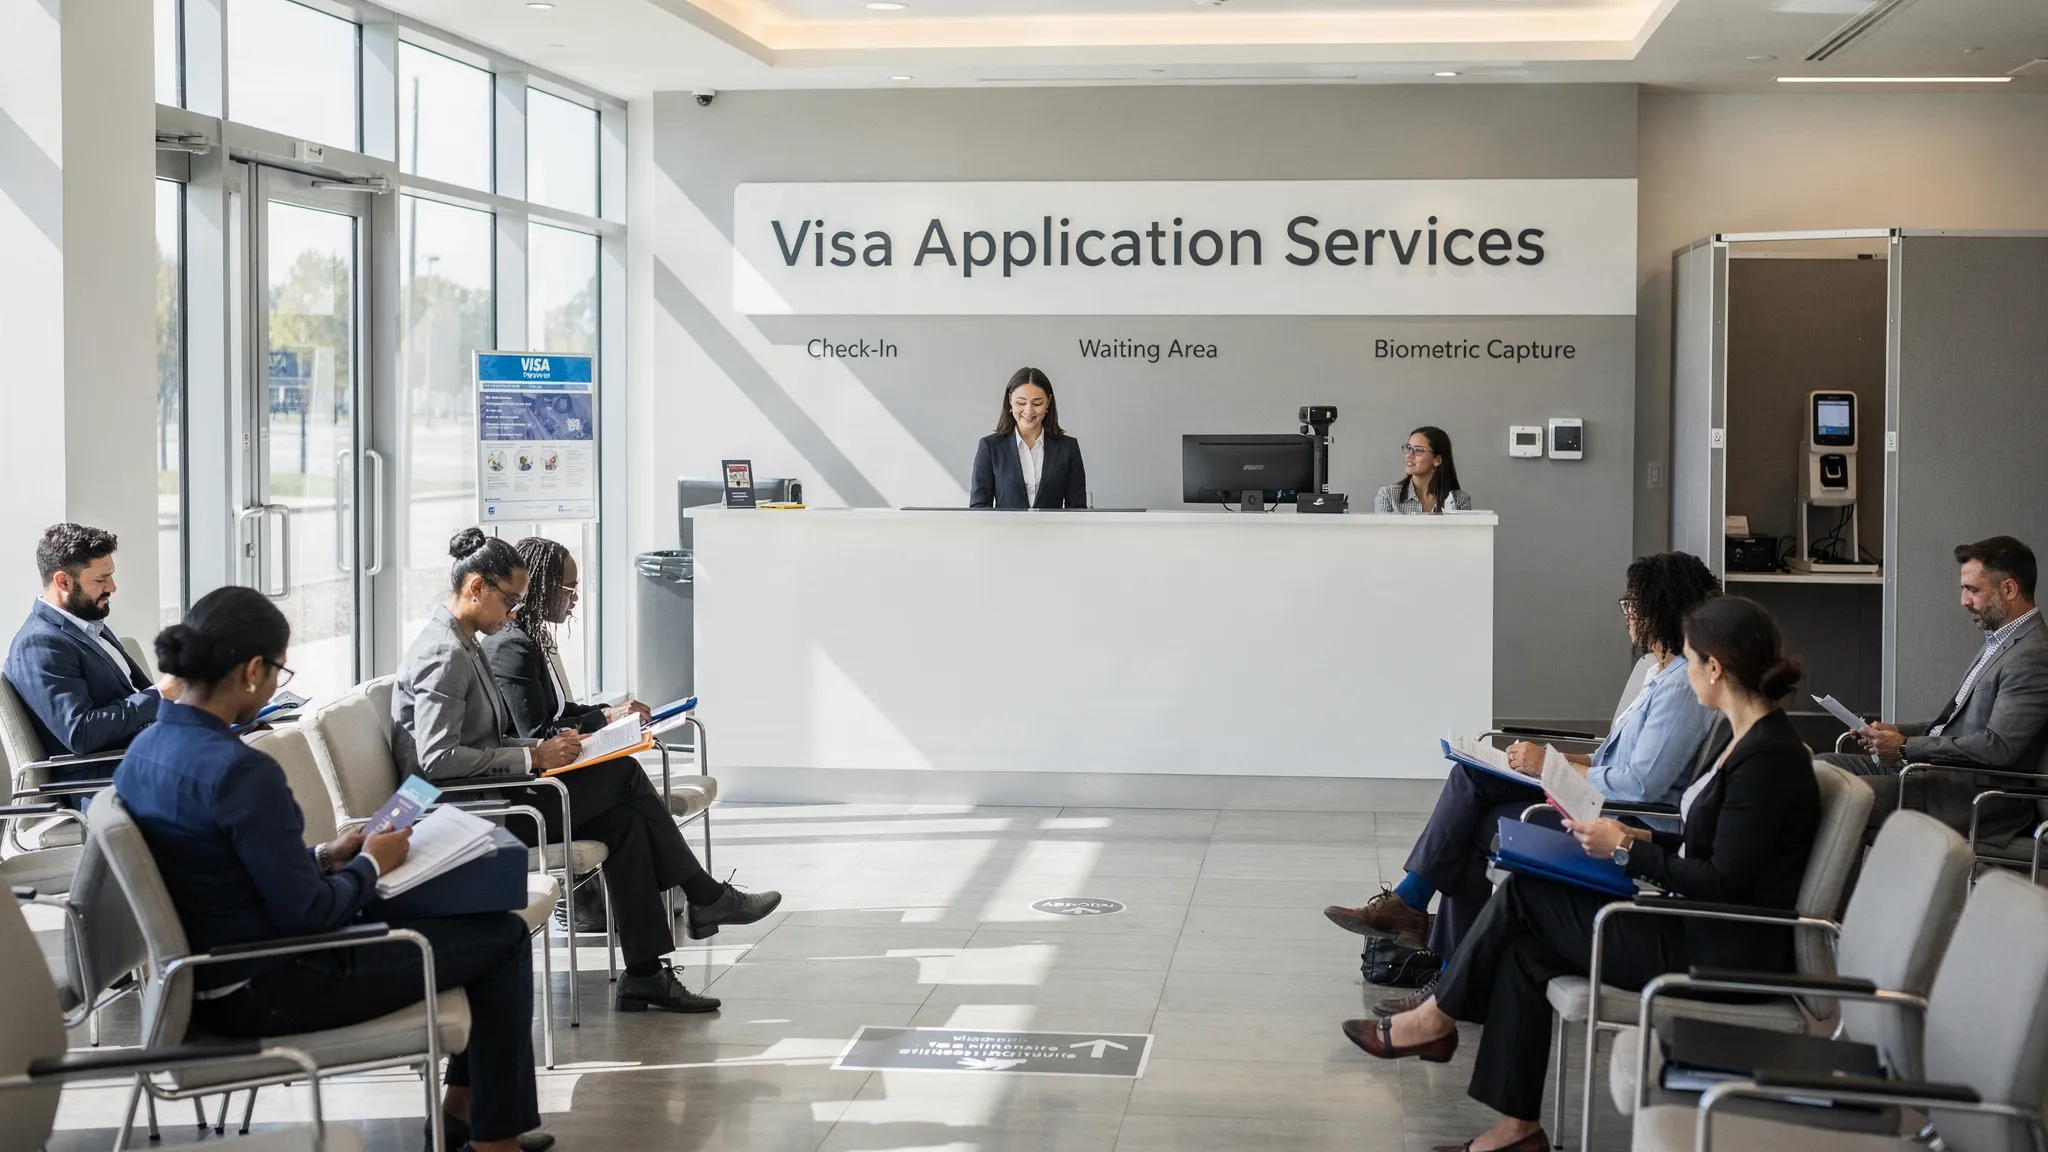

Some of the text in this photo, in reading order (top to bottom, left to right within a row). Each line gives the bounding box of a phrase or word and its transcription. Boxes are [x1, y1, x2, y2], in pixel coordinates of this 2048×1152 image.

[771, 216, 1545, 277] Visa Application Services
[807, 338, 898, 360] Check-In
[1079, 339, 1218, 364] Waiting Area
[1374, 338, 1576, 364] Biometric Capture
[521, 357, 550, 371] VISA
